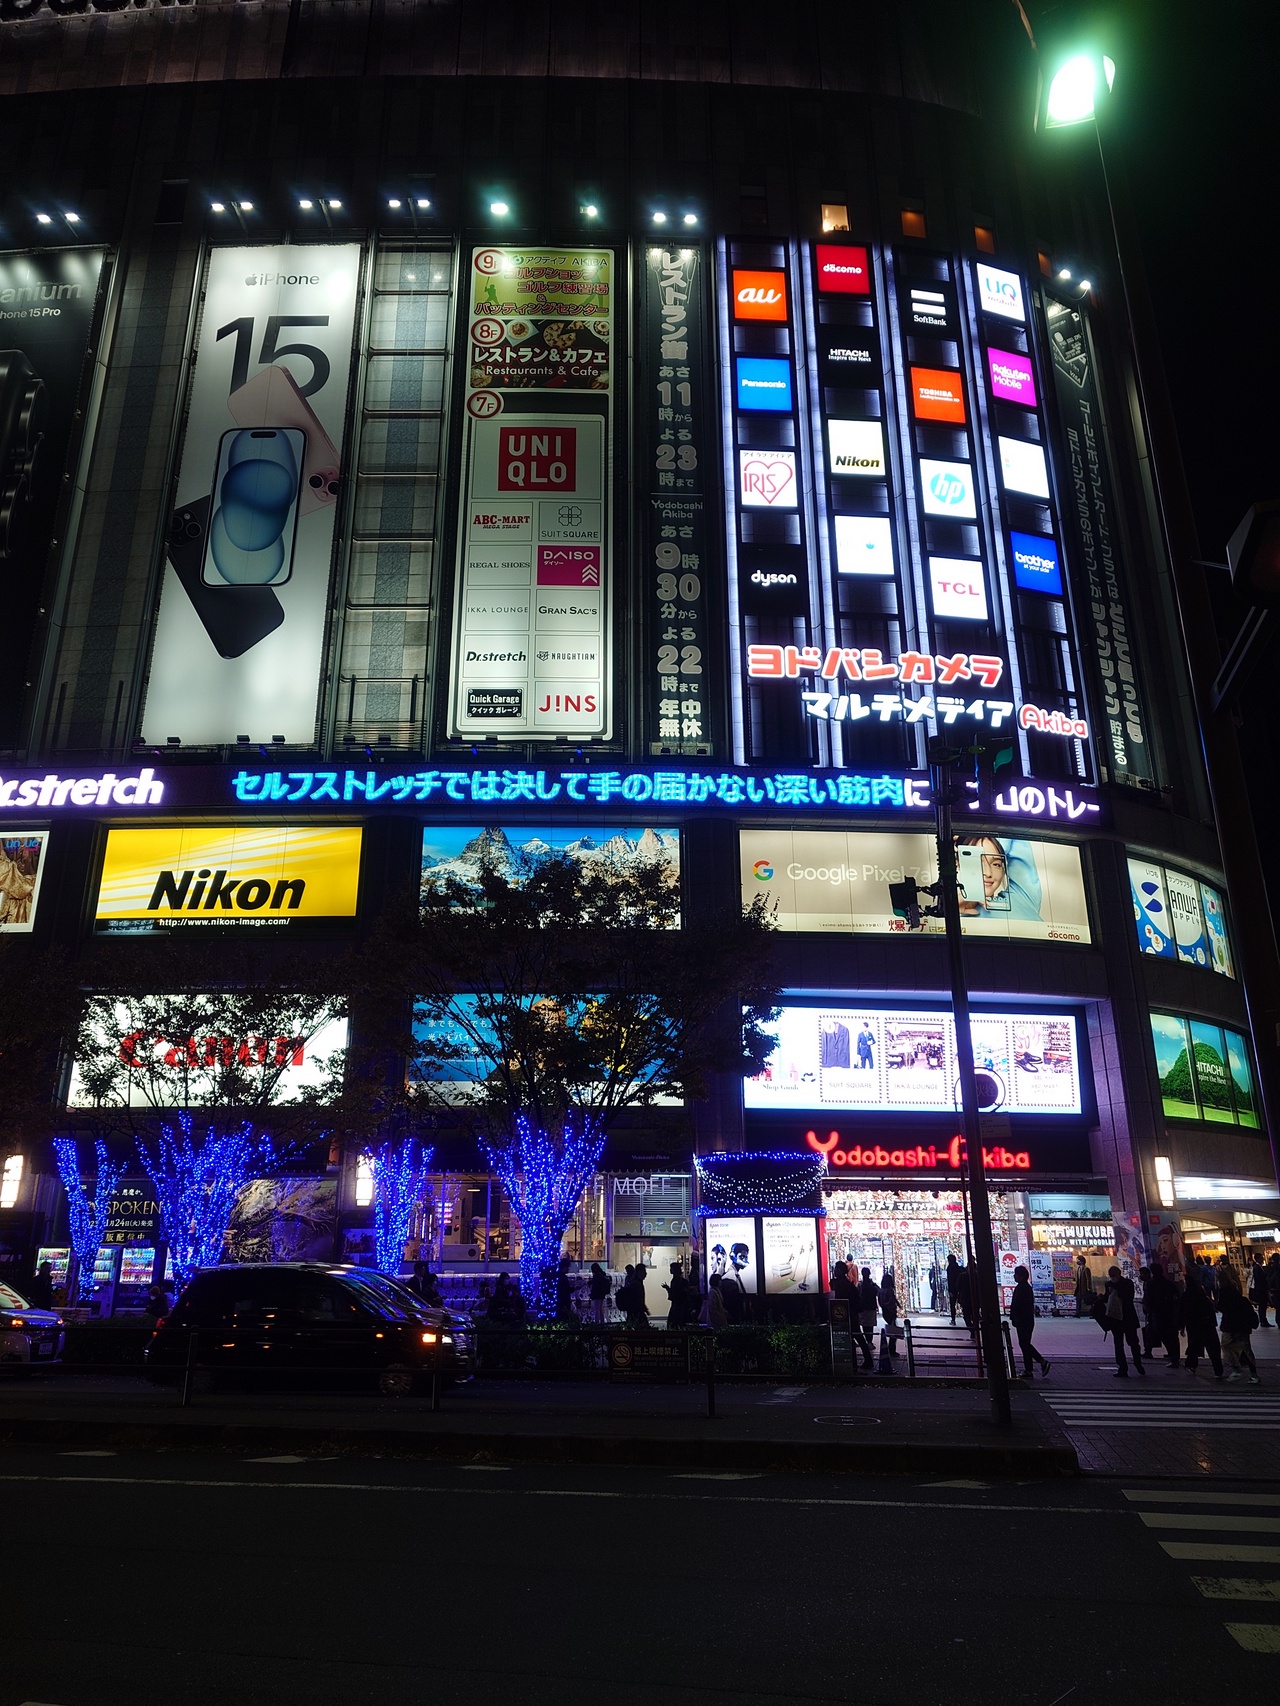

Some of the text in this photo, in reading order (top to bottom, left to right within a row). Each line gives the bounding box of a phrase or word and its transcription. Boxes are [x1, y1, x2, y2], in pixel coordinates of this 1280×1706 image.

[259, 272, 320, 286] iPhone
[737, 287, 782, 304] au
[985, 277, 1018, 301] UQ
[0, 307, 61, 319] hone 15 Pro
[474, 303, 609, 316] バッティングセンター
[913, 314, 947, 326] SoftBank
[479, 324, 498, 339] 8F
[215, 315, 331, 398] 15
[474, 347, 607, 364] レストラン&カフェ
[830, 348, 869, 357] HITACHI
[486, 365, 599, 376] Restaurants & Cafe
[659, 366, 690, 377] あさ
[656, 381, 692, 406] 11
[476, 396, 495, 412] 7F
[658, 407, 692, 422] 時から
[660, 429, 692, 440] よる
[508, 435, 562, 457] UNI
[655, 444, 698, 470] 23
[835, 455, 880, 468] Nikon
[507, 461, 567, 486] QLO
[659, 472, 694, 487] 時まで
[933, 473, 964, 499] hp
[651, 500, 703, 510] Yodobashi
[473, 514, 530, 525] ABC-MART
[662, 509, 694, 519] Akiba
[660, 526, 694, 538] あさ
[543, 550, 594, 560] DAISO
[751, 570, 797, 587] dyson
[656, 573, 701, 601] 30
[937, 581, 980, 596] TCL
[538, 605, 567, 615] GRAN
[660, 603, 698, 619] 分から
[662, 627, 696, 640] よる
[466, 651, 527, 662] Dr.stretch
[656, 645, 703, 675] 22
[748, 644, 1004, 688] ヨドバシカメラ
[661, 676, 699, 693] 時まで
[470, 694, 520, 706] Quick Garage
[659, 699, 701, 717] 年中
[801, 692, 1089, 739] マルチメディア Akiba
[659, 718, 702, 738] 無休
[786, 863, 858, 885] Google
[862, 864, 906, 882] Pixel
[147, 869, 306, 911] Nikon
[614, 1177, 671, 1195] MOFF
